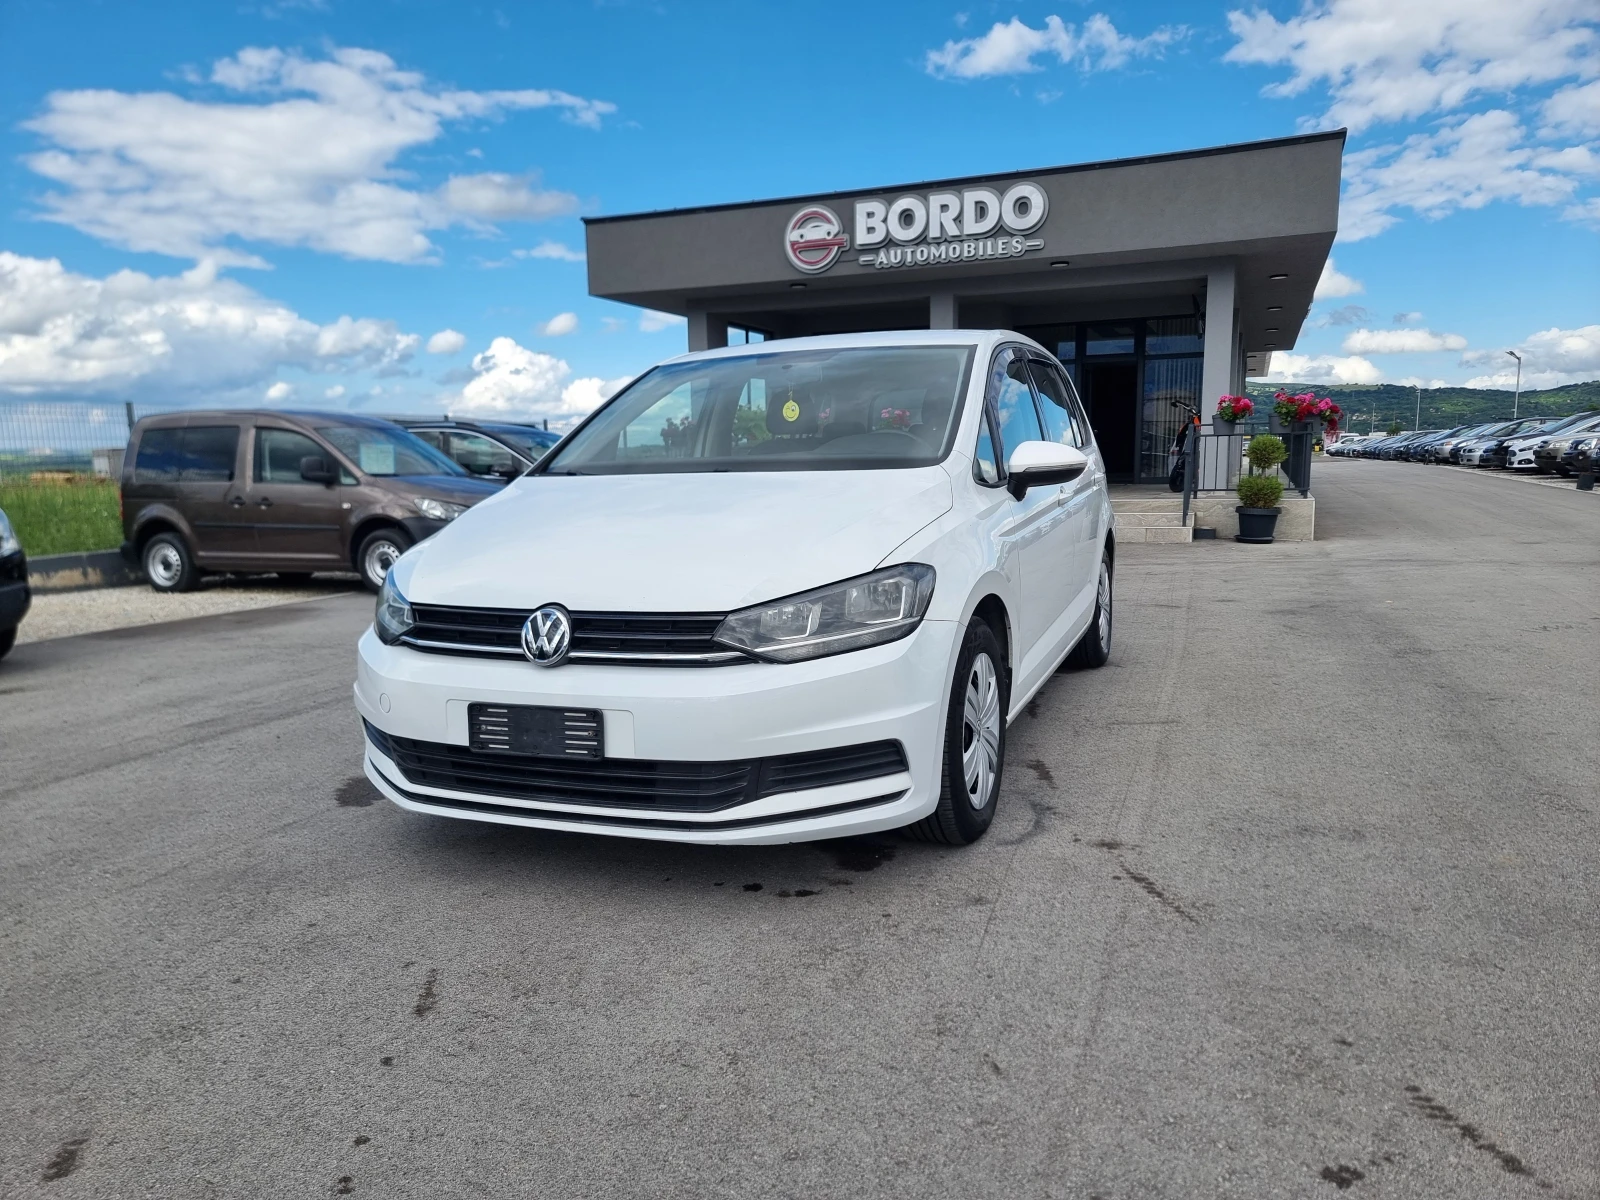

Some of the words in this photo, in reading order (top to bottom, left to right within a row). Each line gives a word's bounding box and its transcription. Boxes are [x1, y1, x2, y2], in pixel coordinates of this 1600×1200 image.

[856, 185, 1044, 245] BORDO
[877, 238, 1022, 265] AUTOMOBILES
[522, 608, 569, 661] VW
